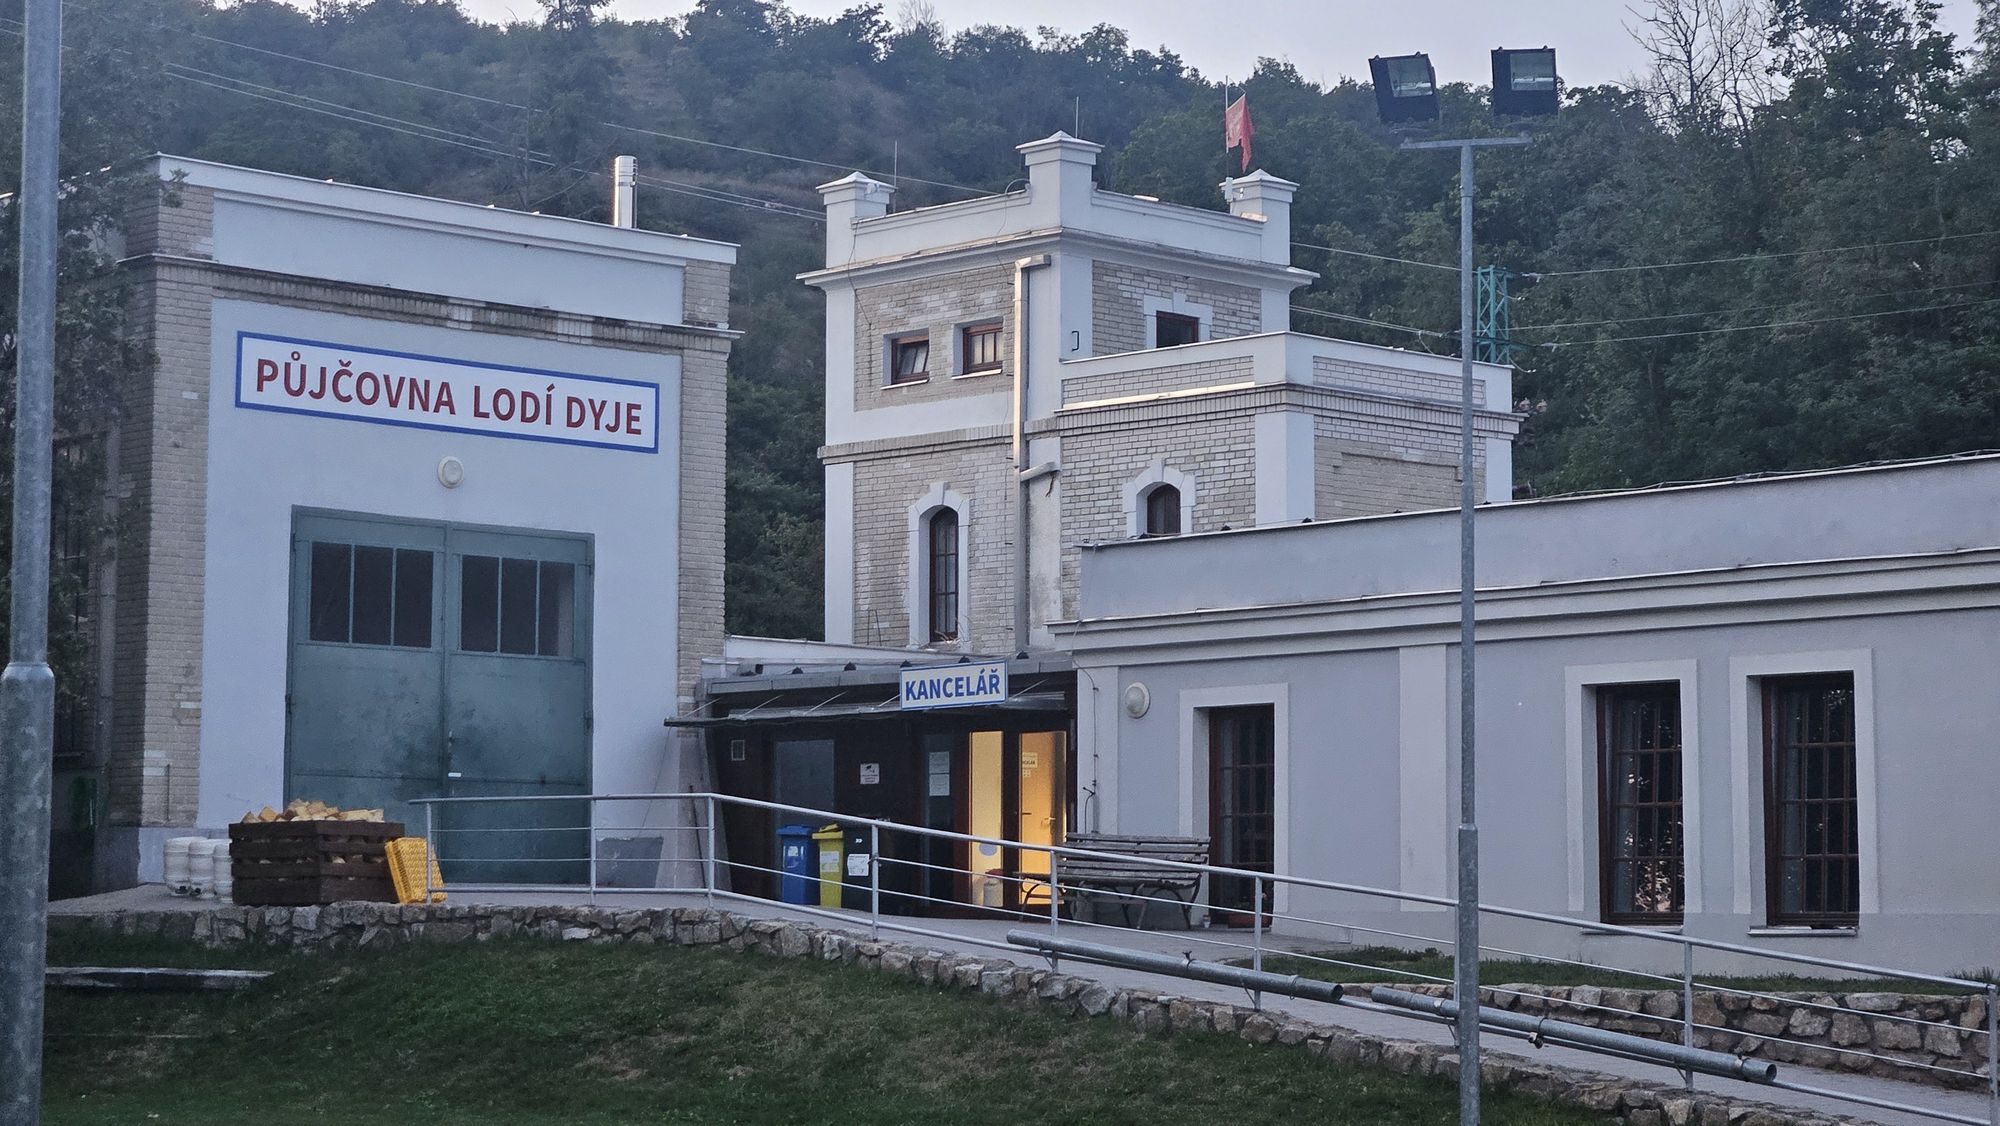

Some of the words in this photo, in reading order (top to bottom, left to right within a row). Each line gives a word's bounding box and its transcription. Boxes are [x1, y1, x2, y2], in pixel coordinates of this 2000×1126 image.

[256, 351, 457, 415] PŮJČOVNA
[473, 383, 555, 426] LODÍ
[566, 396, 642, 435] DYJE
[905, 668, 1000, 701] KANCELÁŘ
